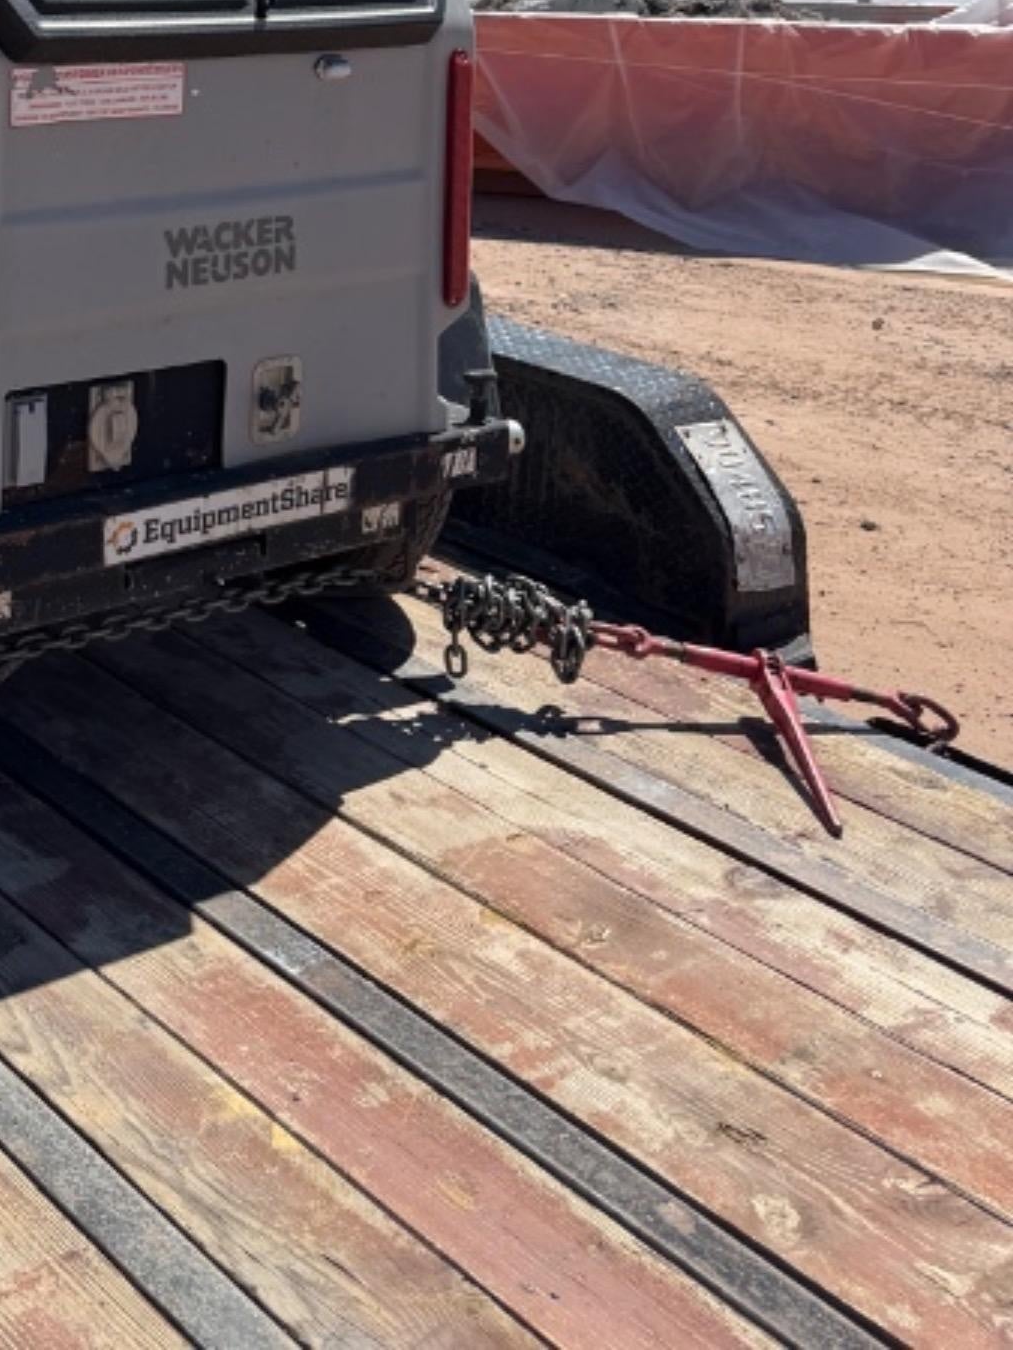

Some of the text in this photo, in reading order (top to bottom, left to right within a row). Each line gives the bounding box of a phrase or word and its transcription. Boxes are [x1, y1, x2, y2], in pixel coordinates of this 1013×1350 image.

[164, 215, 295, 258] WACKER
[165, 243, 296, 290] NEUSON
[142, 480, 350, 545] EquipmentShare
